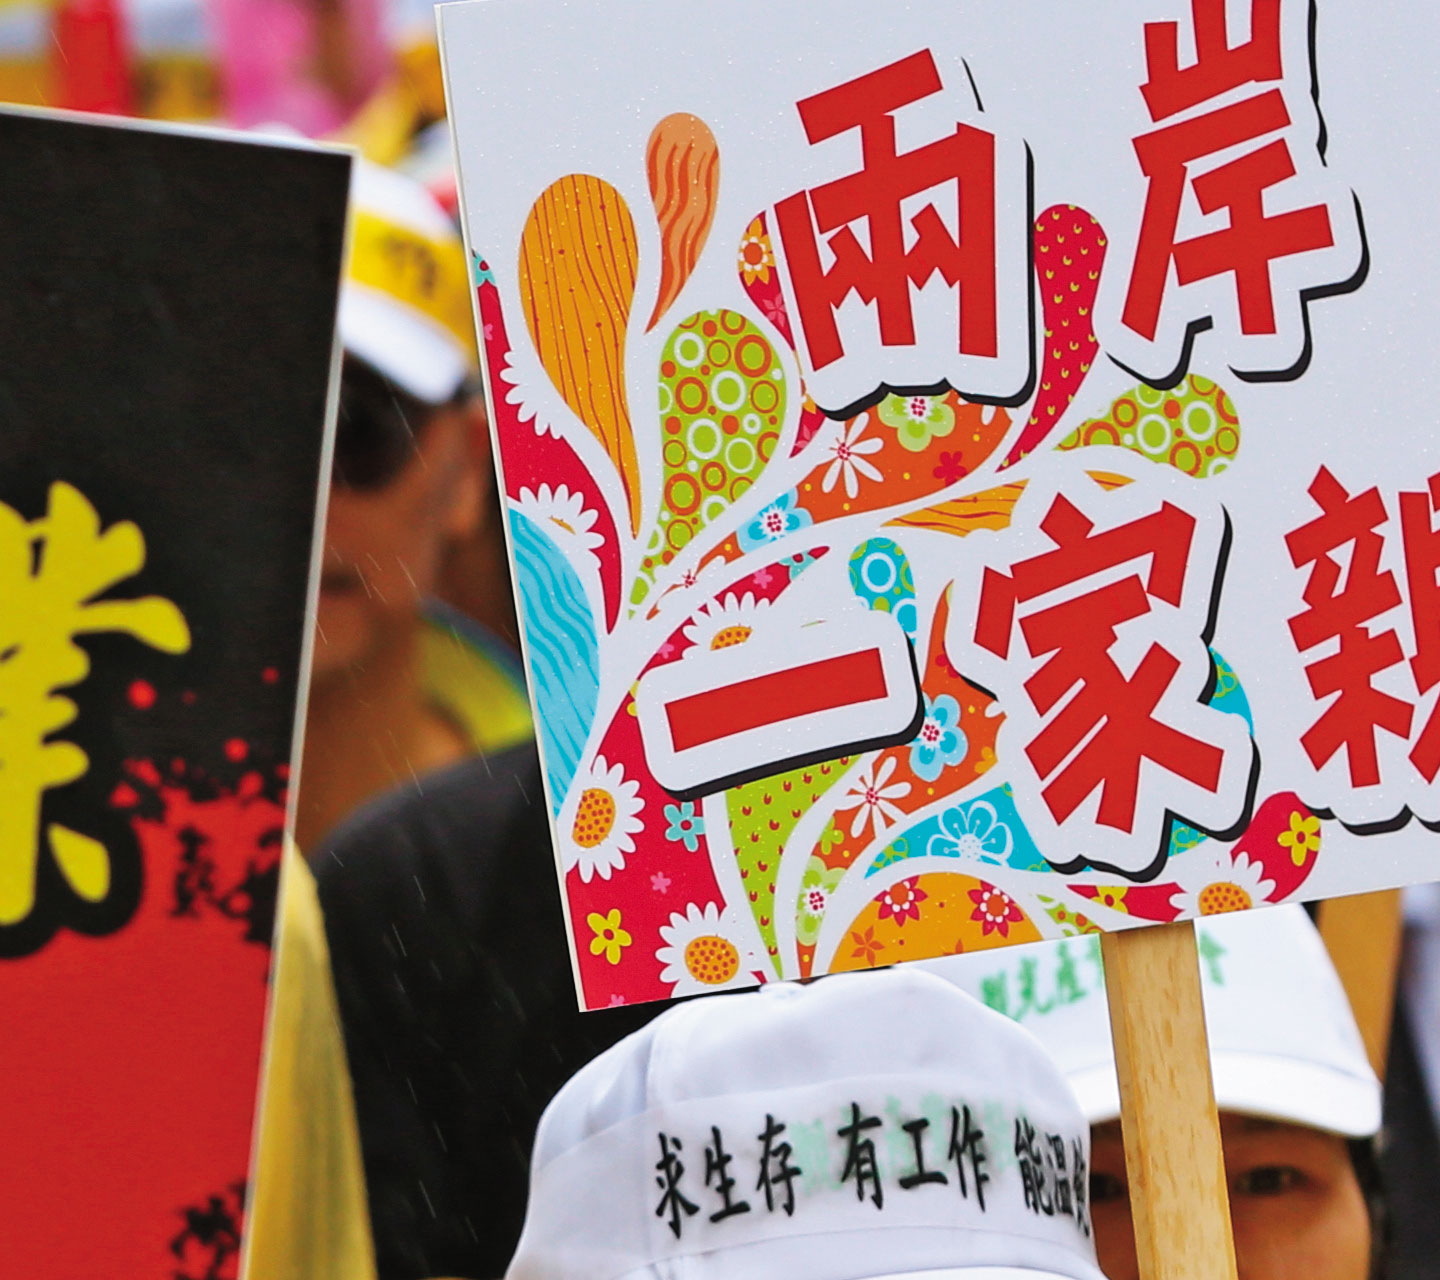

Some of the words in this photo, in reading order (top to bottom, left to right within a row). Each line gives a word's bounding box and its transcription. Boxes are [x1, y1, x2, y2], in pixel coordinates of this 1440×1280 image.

[655, 1113, 803, 1240] 求生存
[836, 1101, 989, 1213] 有工作
